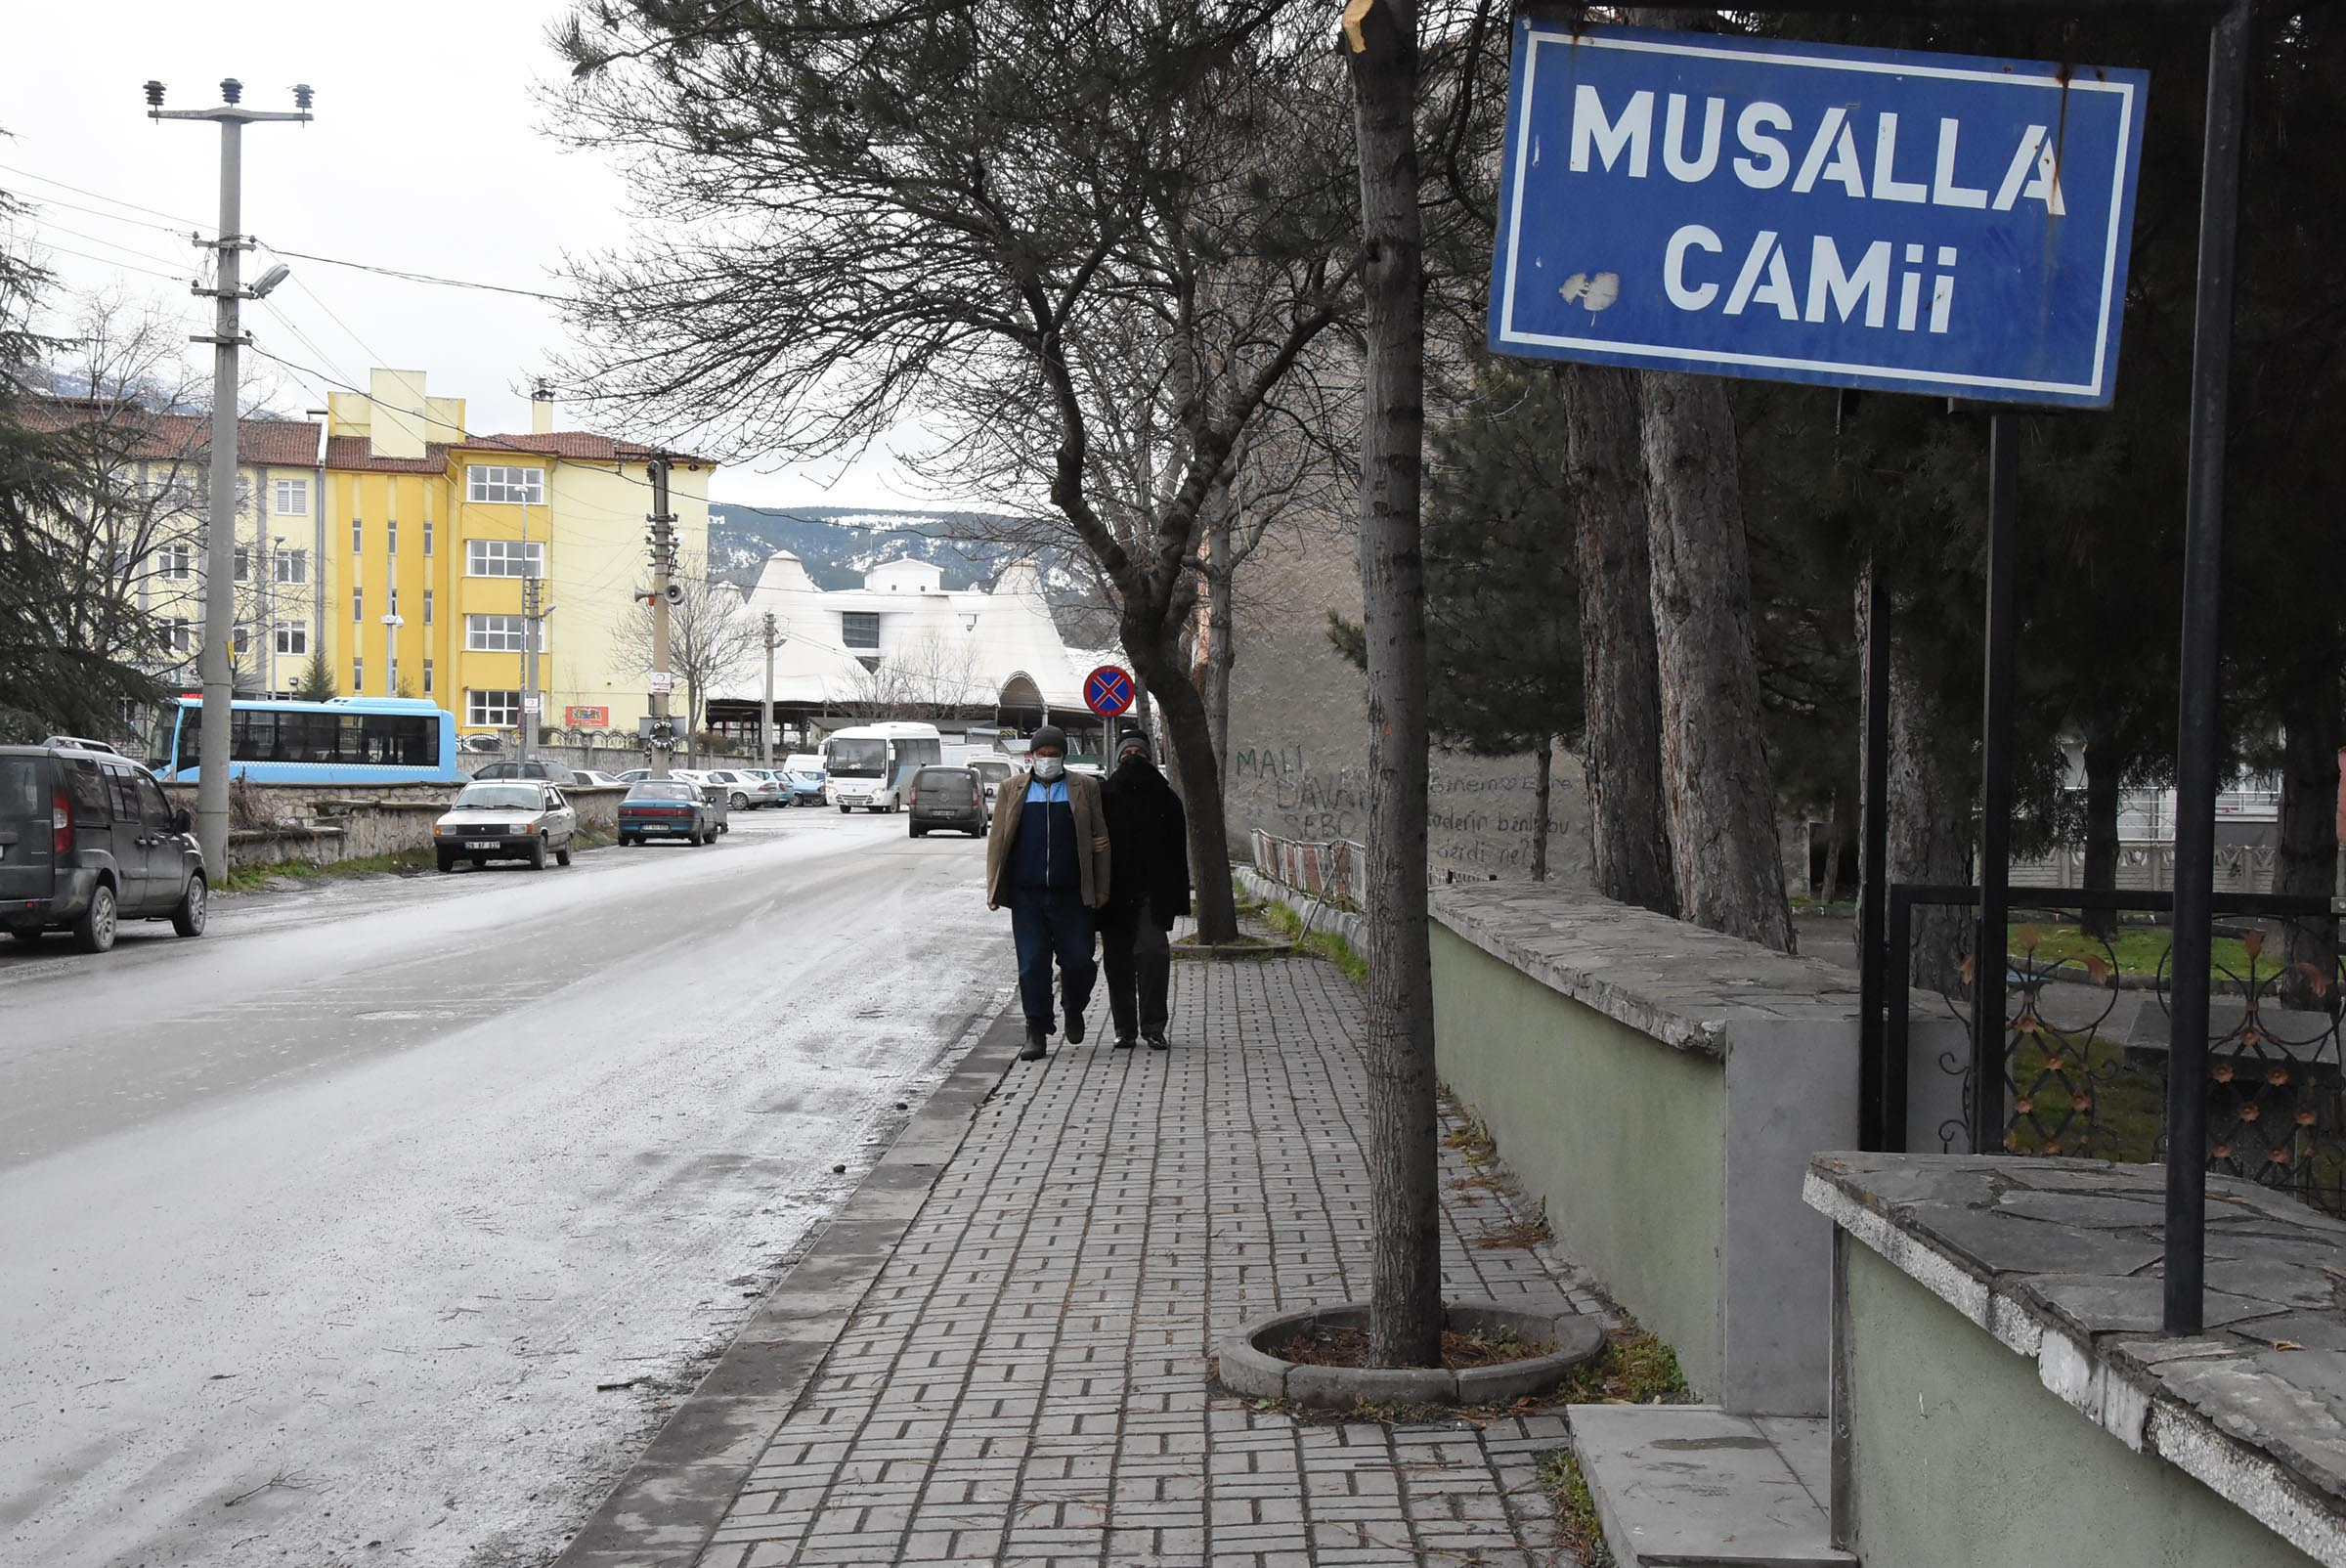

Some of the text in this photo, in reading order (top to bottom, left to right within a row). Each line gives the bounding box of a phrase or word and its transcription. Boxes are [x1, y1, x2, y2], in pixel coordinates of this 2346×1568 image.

[1569, 84, 2066, 216] MUSALLA
[1521, 777, 1573, 790] Ere
[1498, 811, 1539, 832] benl
